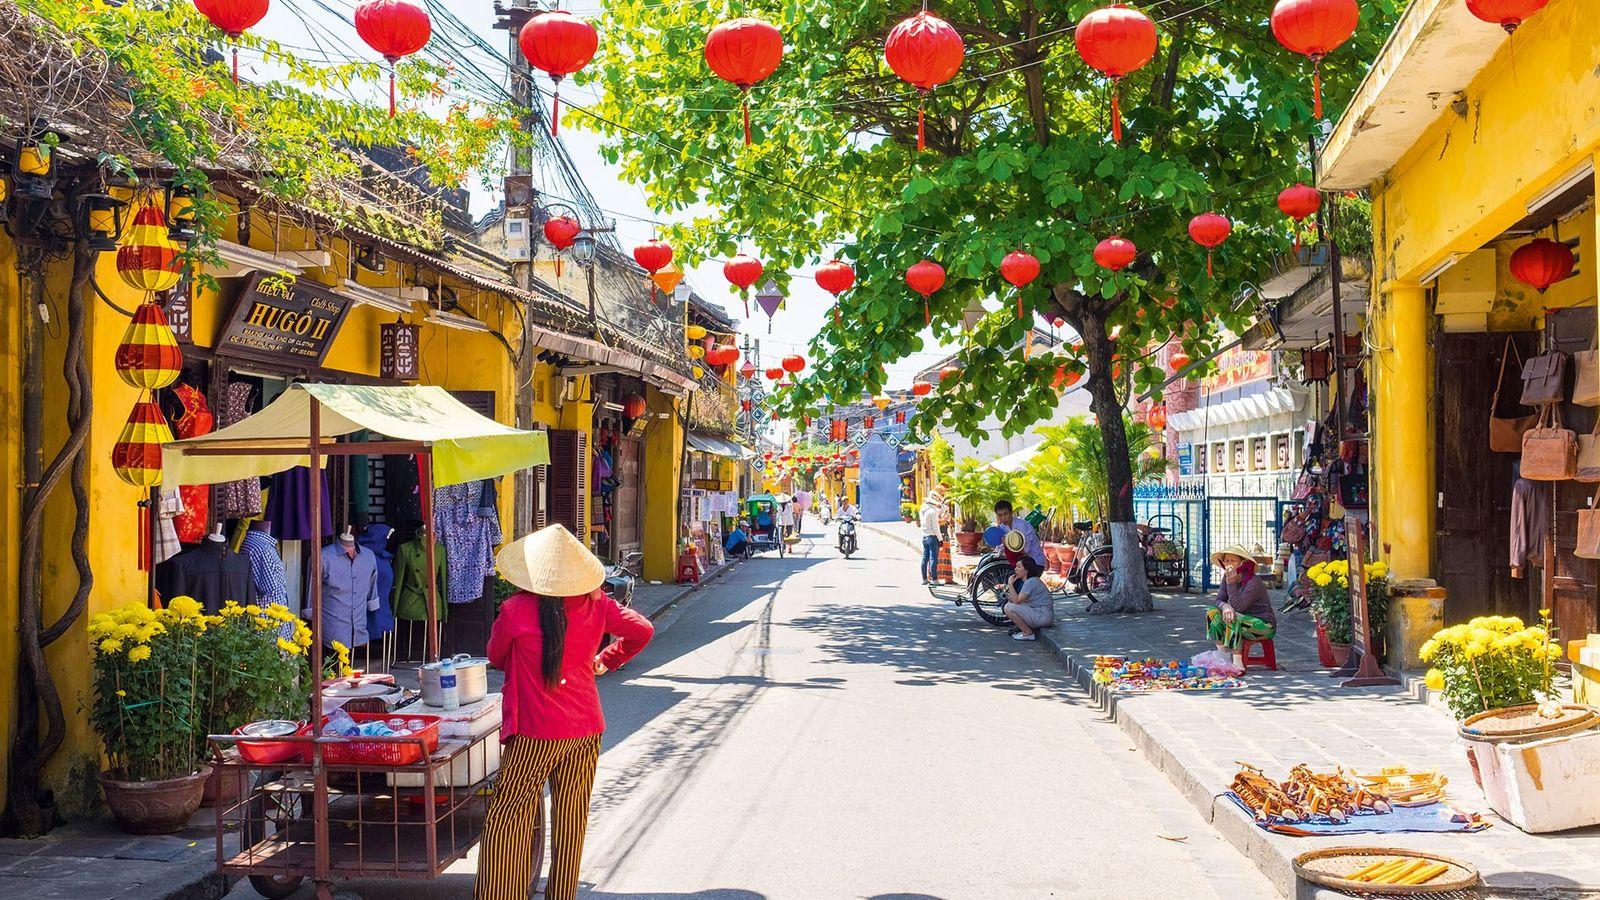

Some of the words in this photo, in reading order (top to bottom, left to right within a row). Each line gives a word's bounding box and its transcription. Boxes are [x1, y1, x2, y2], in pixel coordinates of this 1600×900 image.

[311, 297, 326, 310] Cloth
[326, 301, 341, 316] Shop
[248, 303, 313, 336] HUGÔ
[311, 318, 331, 340] II
